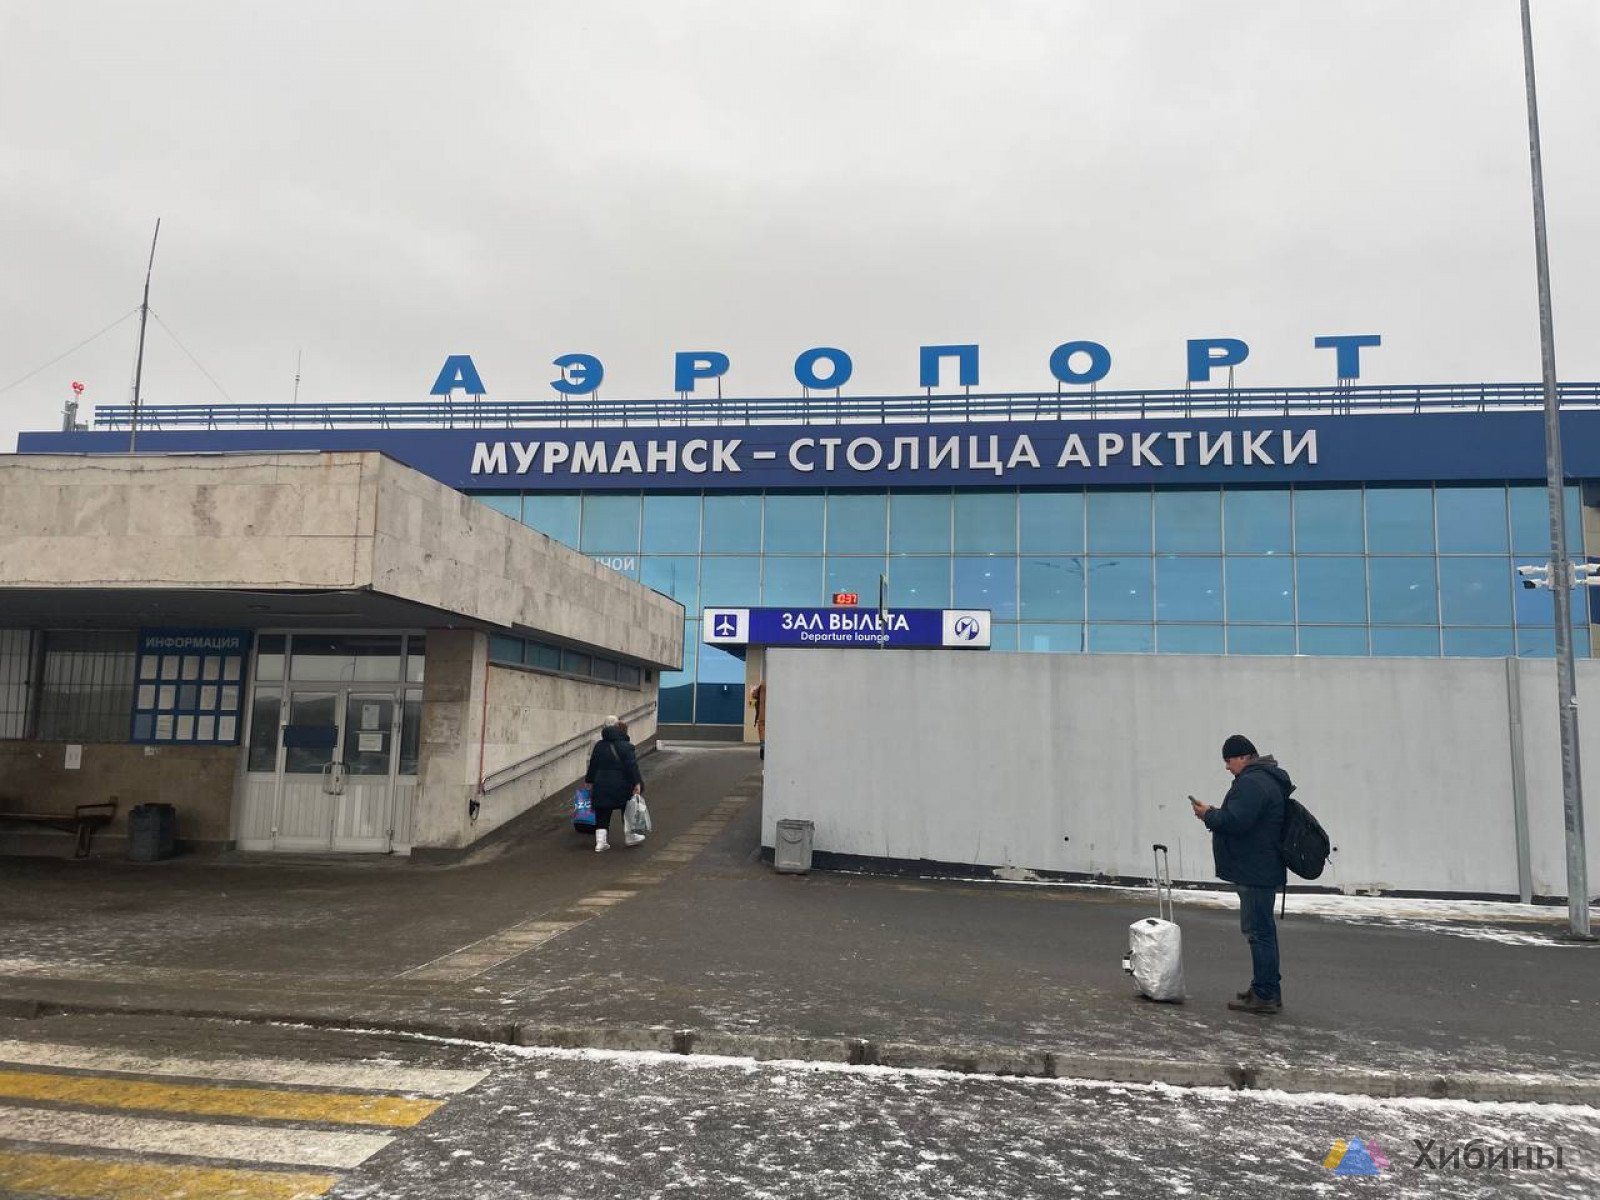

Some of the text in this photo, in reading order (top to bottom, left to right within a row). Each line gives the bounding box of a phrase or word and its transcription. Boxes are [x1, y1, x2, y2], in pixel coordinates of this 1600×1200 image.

[430, 335, 1381, 396] АЭРОПОРТ
[470, 438, 742, 475] МУРМАНСК
[788, 434, 1041, 476] СТОЛИЦА
[1056, 429, 1318, 469] АРКТИКИ
[781, 613, 824, 630] ЗАЛ
[145, 637, 240, 650] ИНФОРМАЦИЯ
[800, 631, 890, 644] Departure lounge
